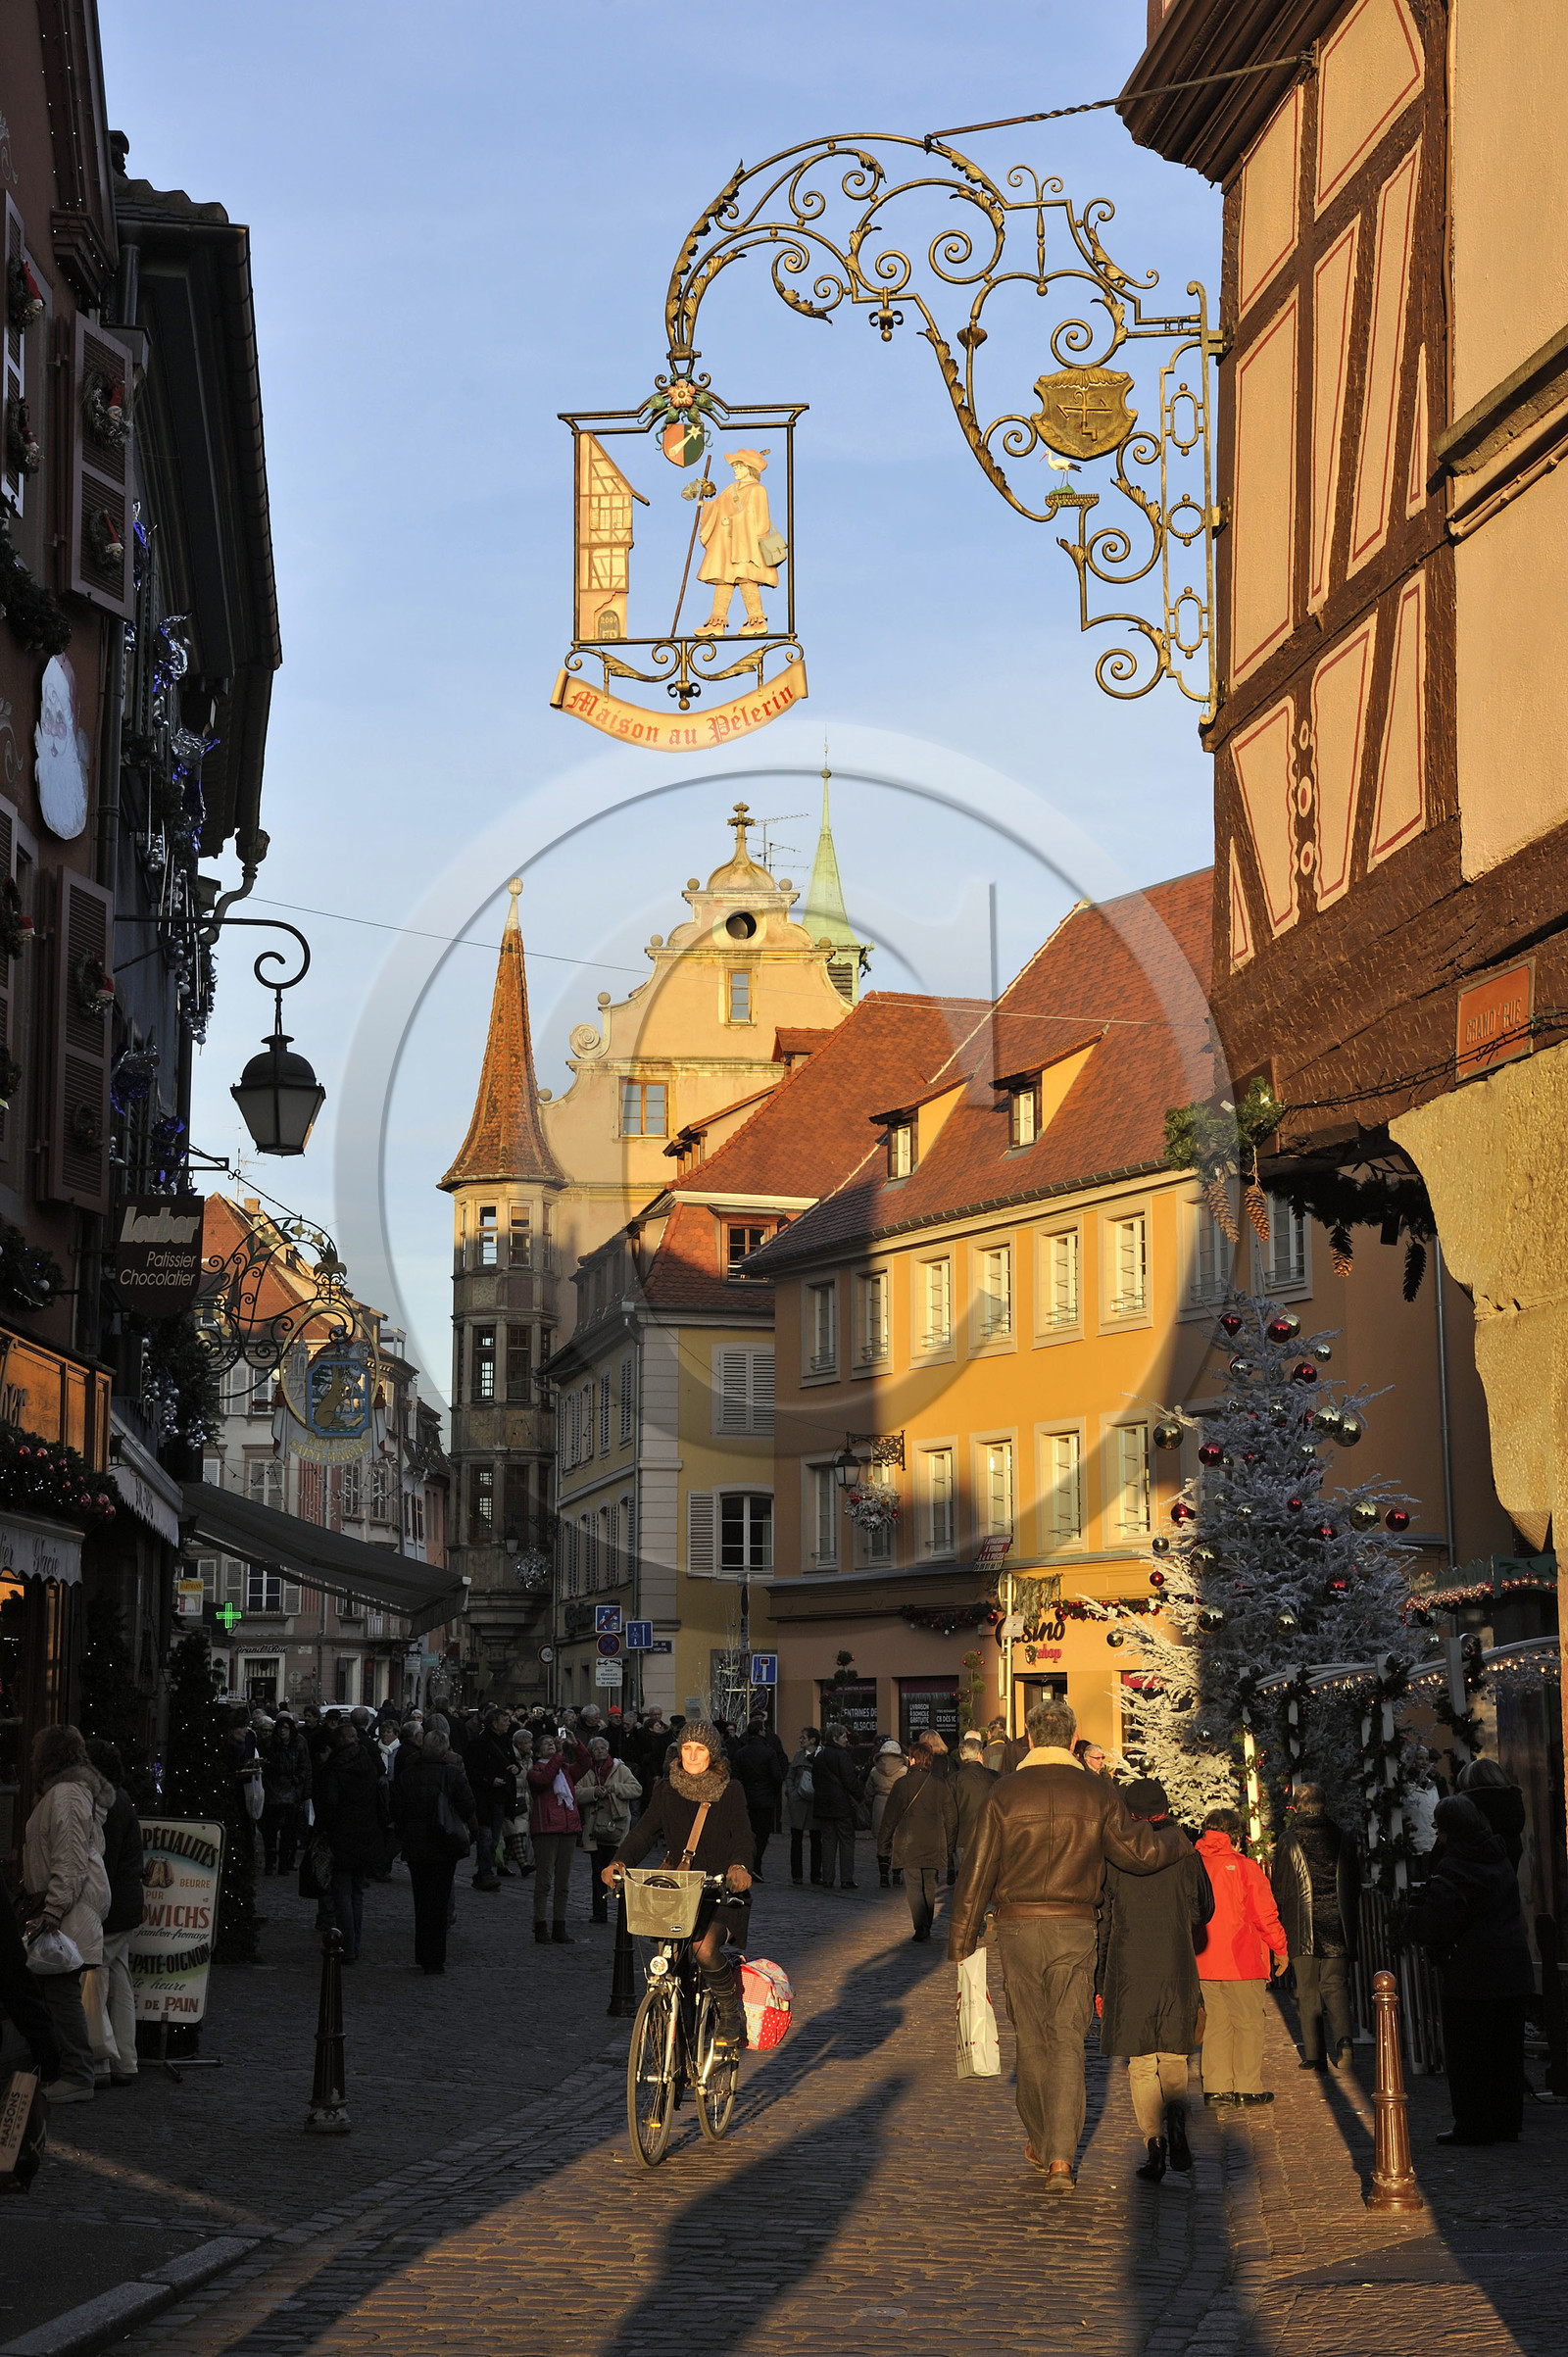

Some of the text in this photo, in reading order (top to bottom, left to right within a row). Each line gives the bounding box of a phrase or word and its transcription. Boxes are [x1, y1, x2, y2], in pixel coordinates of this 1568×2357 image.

[565, 684, 794, 745] Maison au Pélerin
[120, 1206, 201, 1244] Lorber
[120, 1268, 196, 1287] Chocolatier
[0, 1338, 27, 1428] ber
[288, 1438, 370, 1463] SAINT-MARTIN
[1037, 1644, 1062, 1663] shop
[142, 1826, 220, 1869] PÉCIALITÉS
[145, 1890, 165, 1900] PUR
[179, 1878, 211, 1890] BEURRE
[141, 1904, 211, 1929] DWICHS
[150, 1976, 186, 1991] heure
[144, 1999, 160, 2011] DE
[163, 1995, 200, 2013] PAIN
